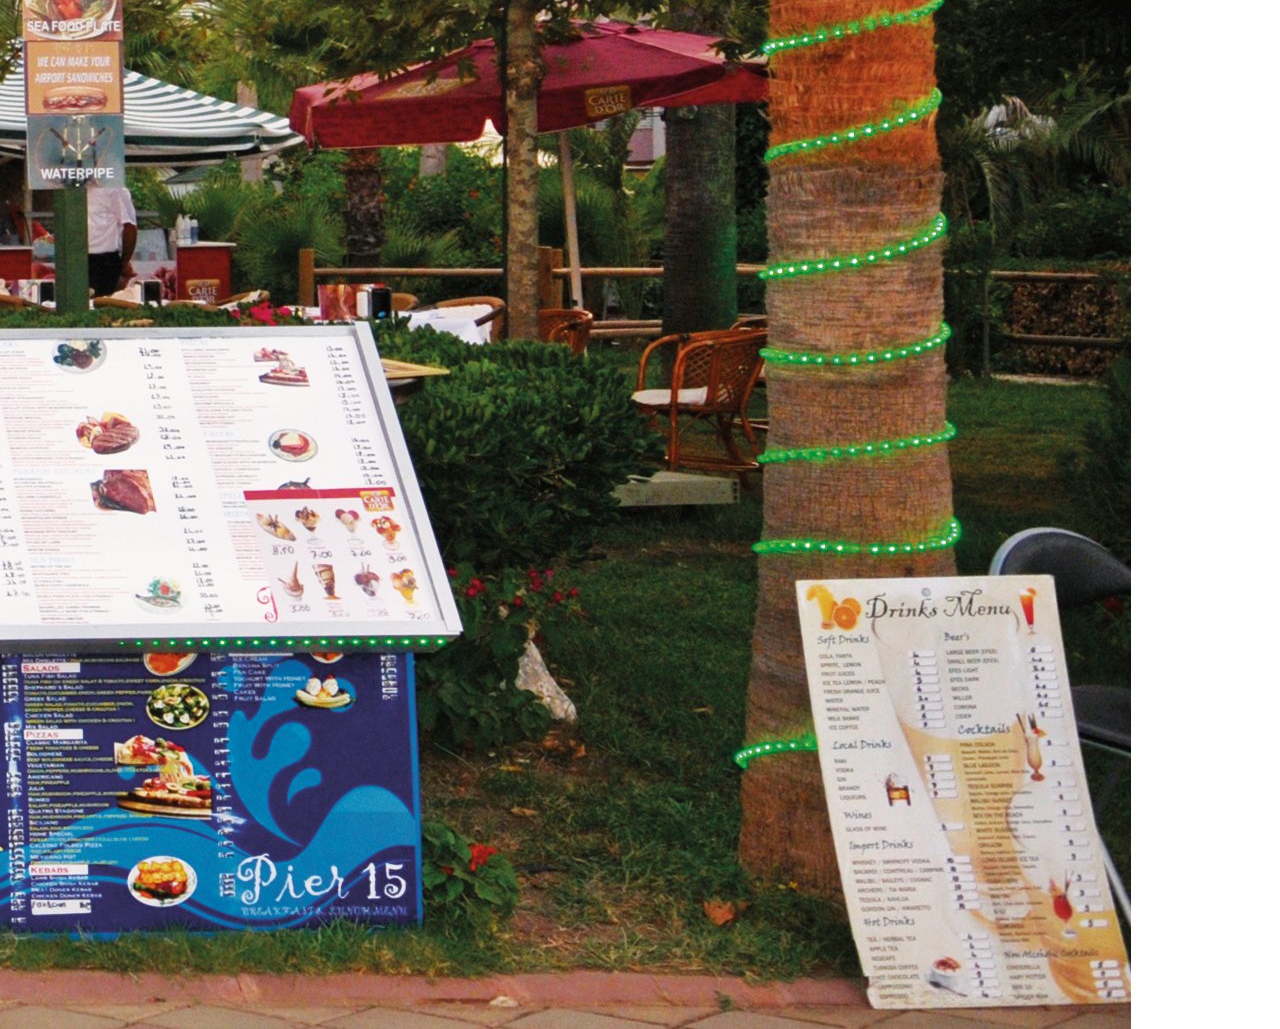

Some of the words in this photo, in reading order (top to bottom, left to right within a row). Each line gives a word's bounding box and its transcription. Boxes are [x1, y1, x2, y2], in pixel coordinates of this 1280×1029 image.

[27, 21, 50, 32] SEA
[37, 56, 49, 67] WE
[50, 56, 66, 67] CAN
[67, 56, 89, 67] MAKE
[91, 56, 112, 67] YOUR
[35, 72, 65, 83] AIRPORT
[67, 72, 113, 83] SANDWICHES
[588, 93, 627, 107] CARTE
[40, 168, 114, 180] WATERPIPE
[865, 592, 938, 619] Drinks
[943, 588, 1011, 617] Menu
[817, 635, 836, 649] Soft
[838, 634, 870, 644] Drinks
[22, 664, 61, 672] SALADS
[958, 723, 1011, 735] Cocktails
[832, 740, 858, 750] Local
[860, 739, 891, 750] Drinks
[843, 811, 872, 819] Wines
[849, 841, 879, 855] Import
[881, 839, 913, 850] Drinks
[30, 866, 69, 874] KEBABS
[237, 852, 350, 905] Pier
[361, 862, 407, 900] 15
[864, 917, 881, 927] Hot
[883, 916, 915, 927] Drinks
